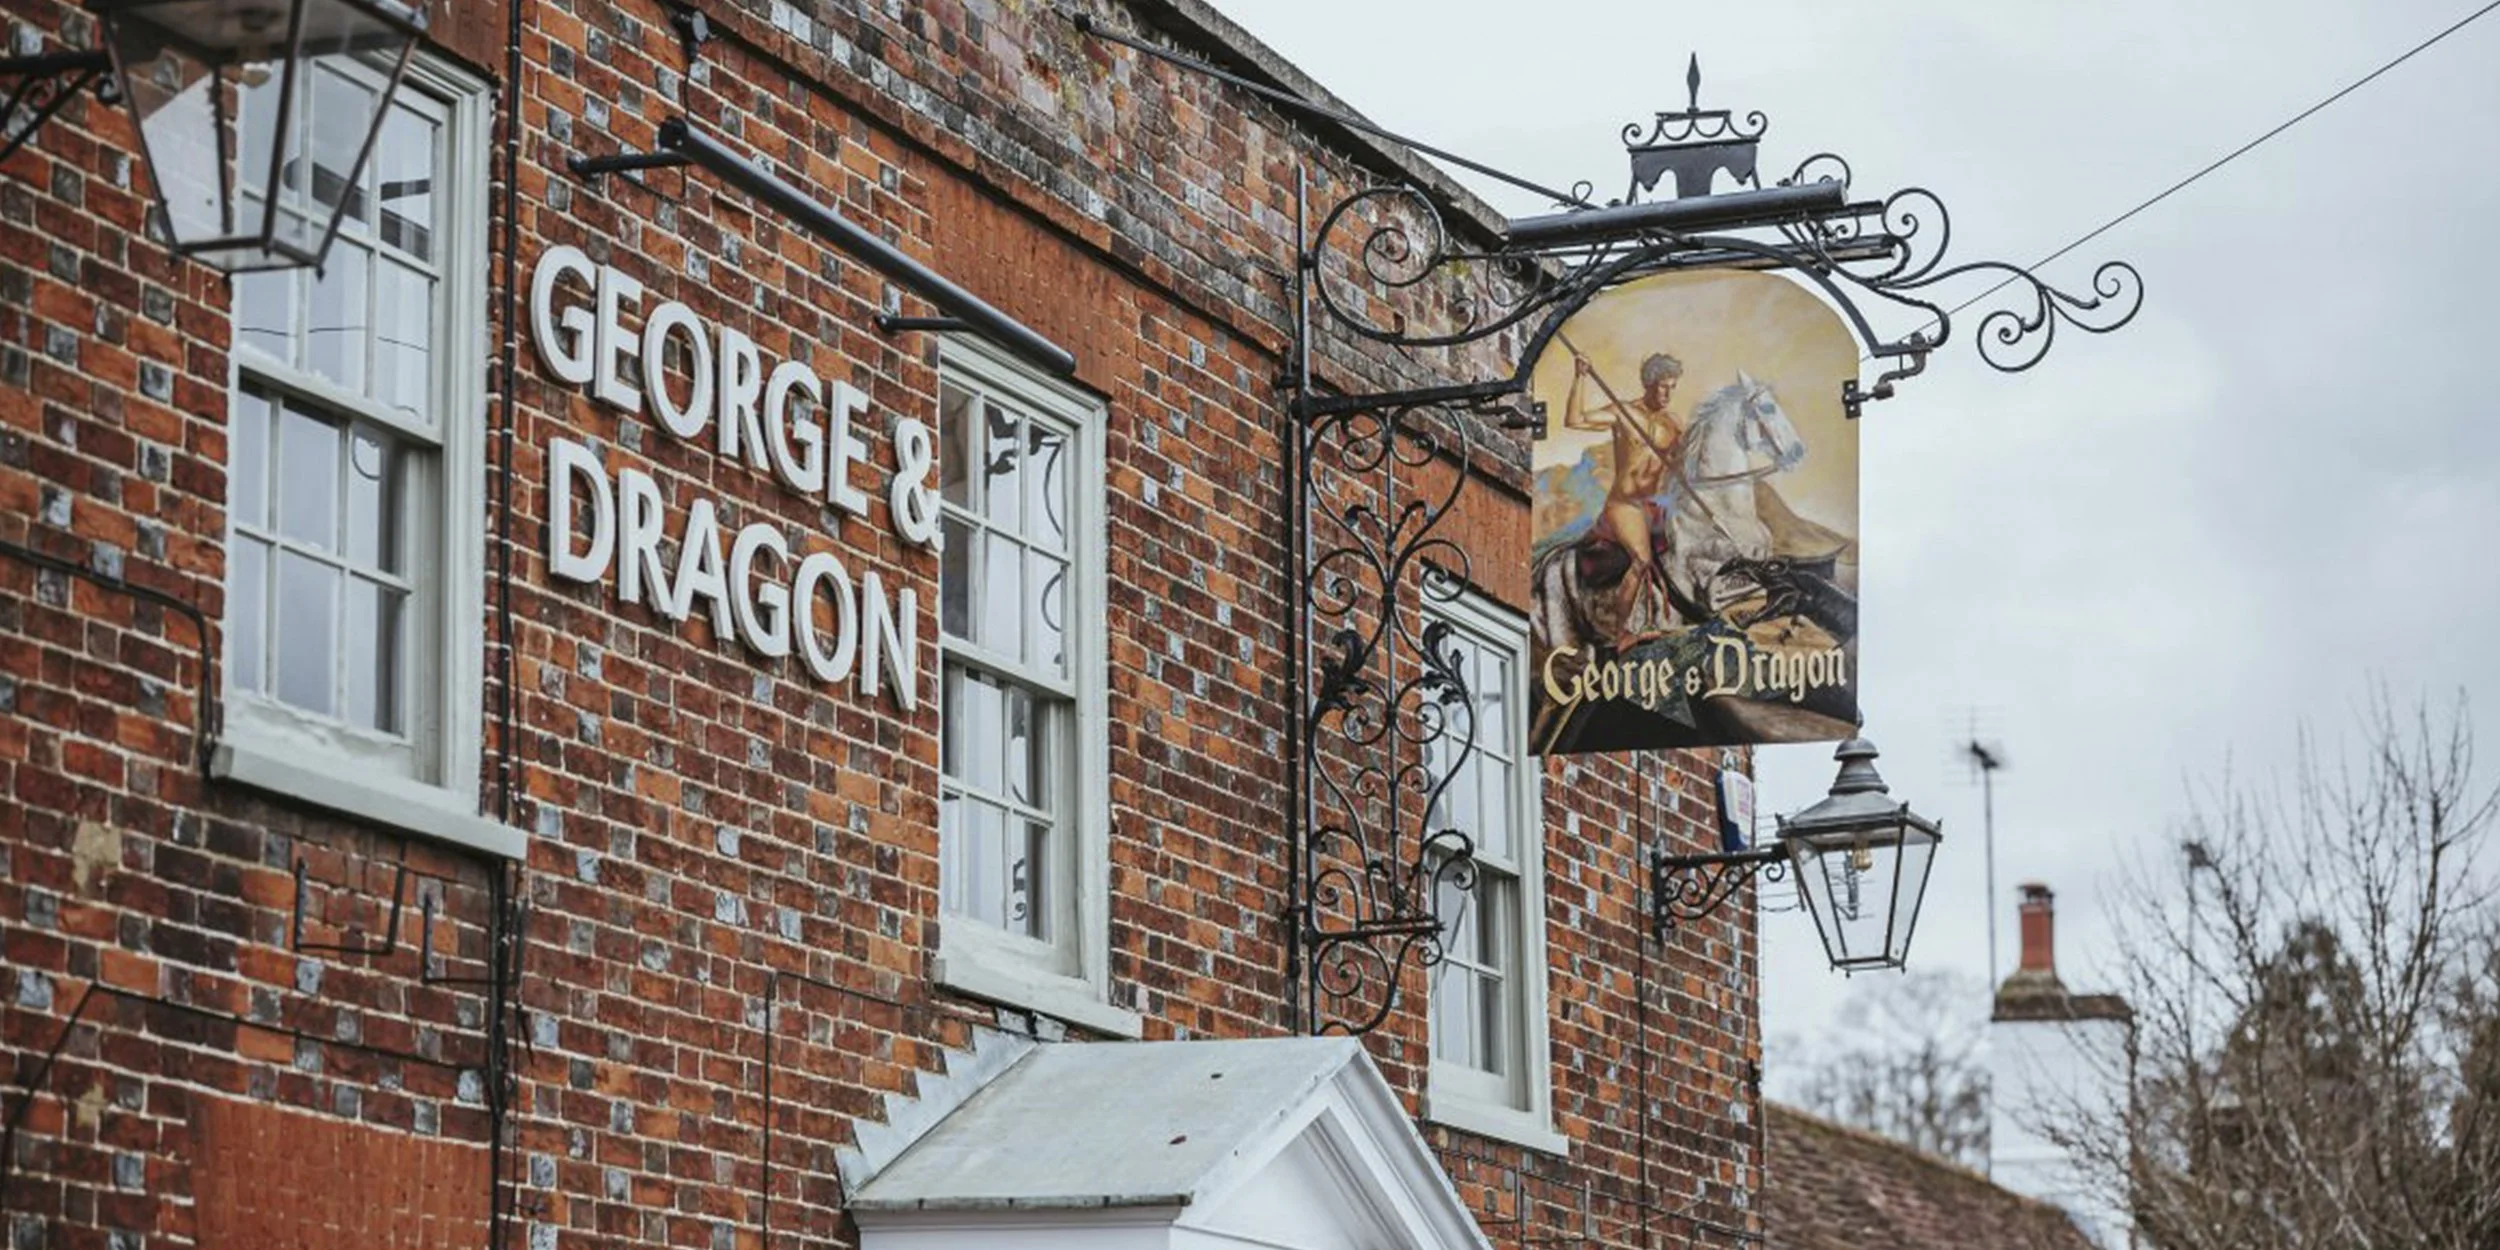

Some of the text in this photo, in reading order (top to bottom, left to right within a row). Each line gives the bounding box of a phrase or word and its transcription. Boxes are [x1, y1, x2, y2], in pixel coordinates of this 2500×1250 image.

[530, 244, 944, 552] GEORGE &
[548, 436, 917, 713] DRAGON
[1542, 632, 1848, 711] George & Dragon
